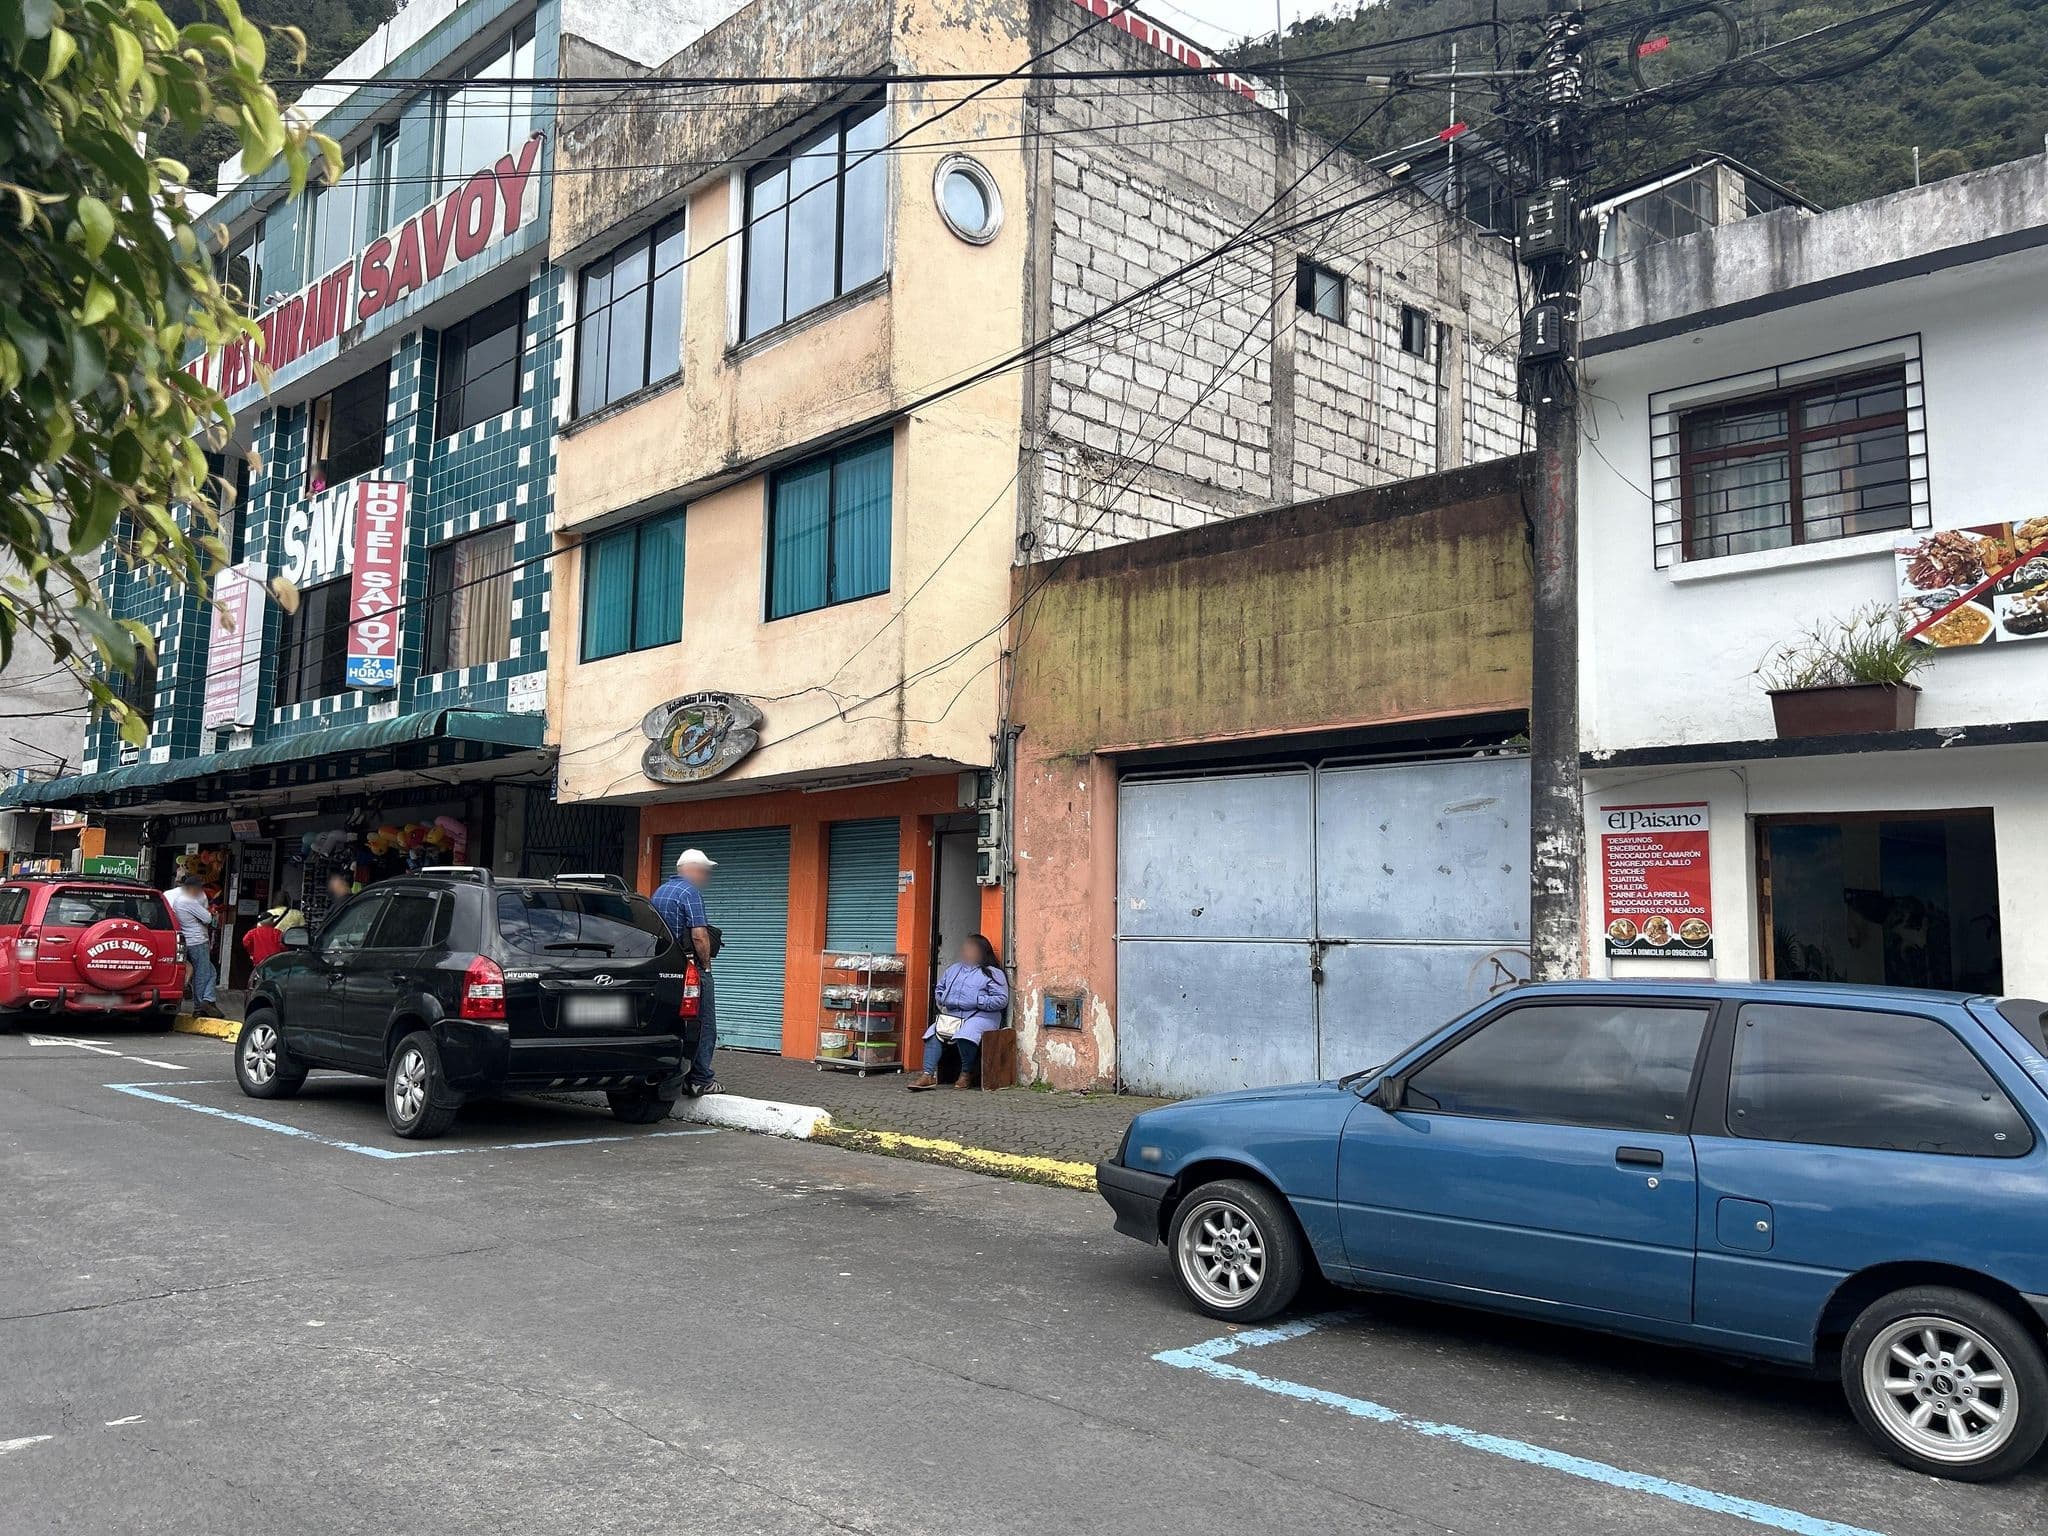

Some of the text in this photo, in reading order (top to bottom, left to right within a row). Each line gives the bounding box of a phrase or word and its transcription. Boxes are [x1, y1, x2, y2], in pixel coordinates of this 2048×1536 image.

[358, 138, 542, 320] SAVOY
[1526, 214, 1534, 227] A
[365, 482, 399, 564] HOTEL
[356, 571, 393, 655] SAVOY
[349, 668, 394, 679] HORAS
[362, 658, 381, 669] 24
[1607, 810, 1701, 832] El Paisano
[87, 939, 154, 959] HOTEL SAVOY
